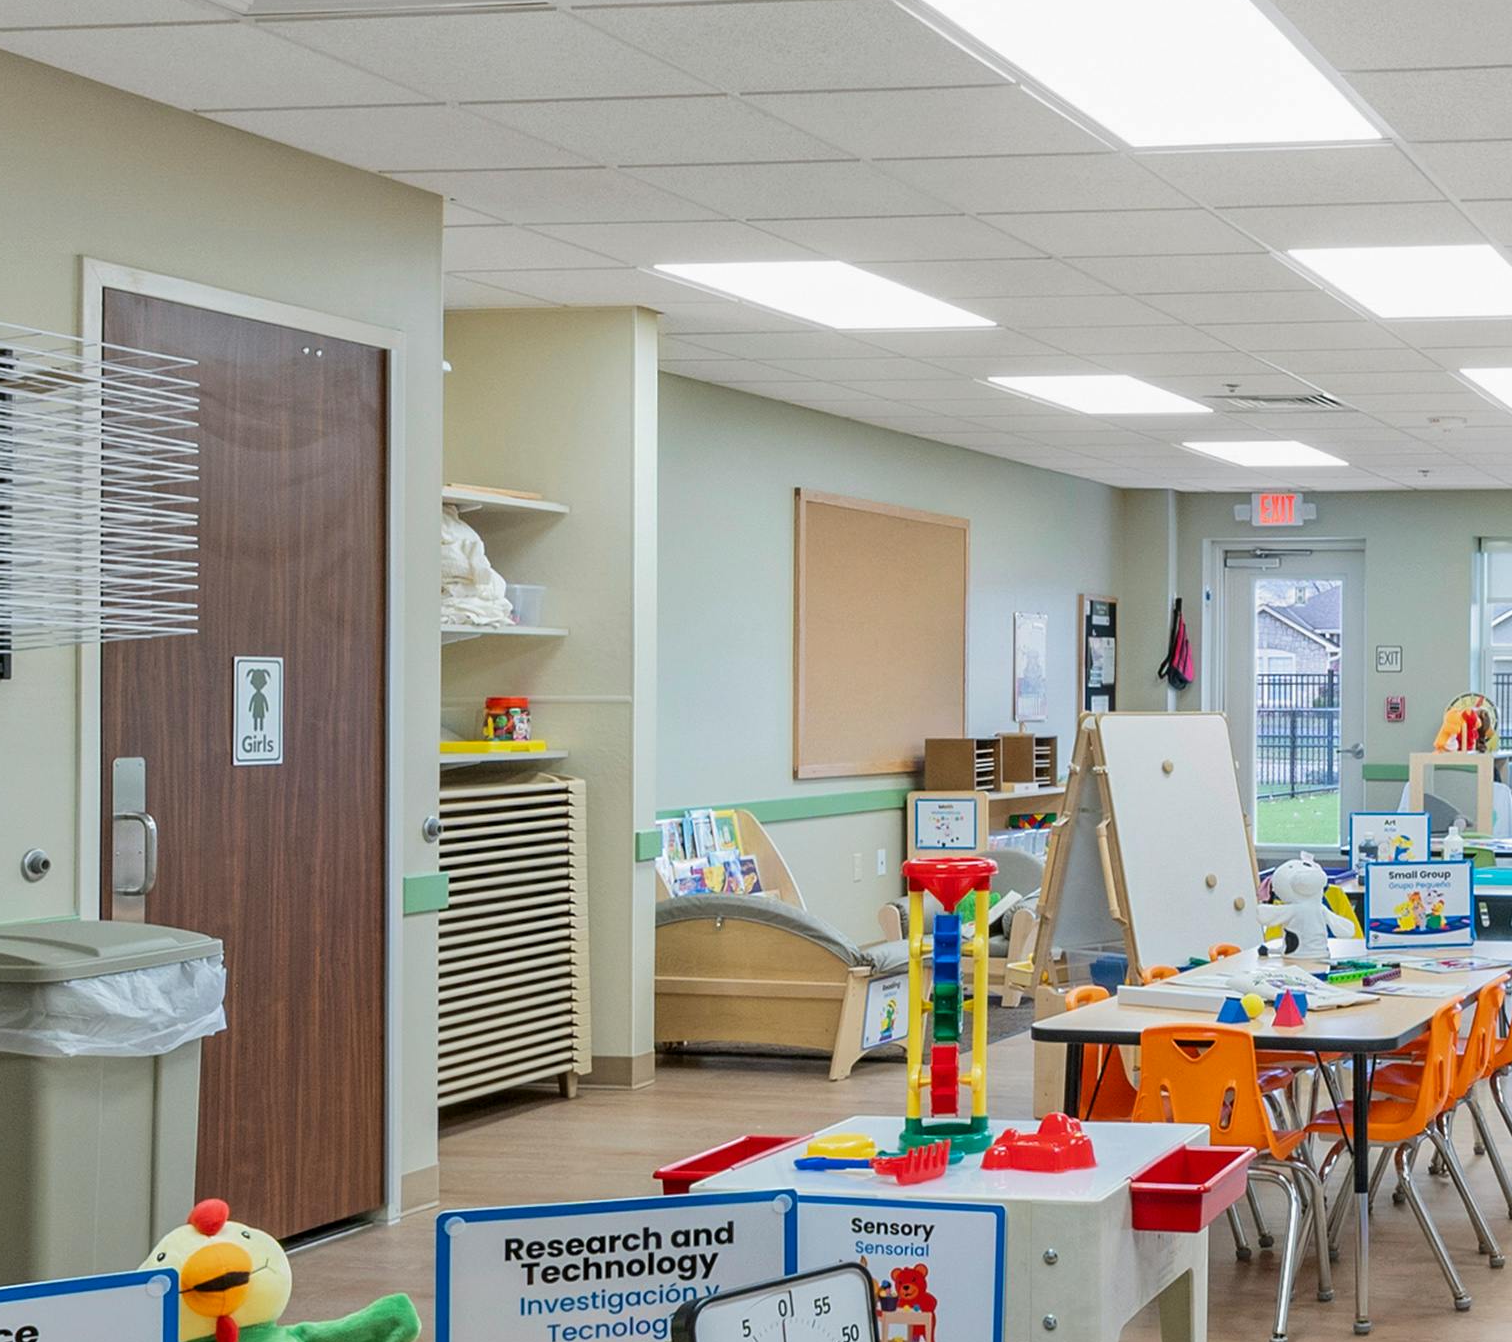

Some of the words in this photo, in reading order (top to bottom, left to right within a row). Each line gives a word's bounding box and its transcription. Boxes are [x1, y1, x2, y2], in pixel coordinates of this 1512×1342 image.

[1259, 494, 1297, 524] EXIT
[1378, 650, 1400, 666] EXIT
[241, 734, 274, 754] Girls
[1384, 819, 1397, 827] Art
[1388, 870, 1418, 880] Small
[1419, 870, 1452, 881] Group
[1388, 882, 1414, 890] Grupo
[1415, 880, 1452, 890] Pequeño
[851, 1217, 935, 1243] Sensory
[504, 1226, 663, 1262] Research
[670, 1221, 735, 1249] and
[855, 1240, 930, 1257] Sensorial
[520, 1252, 720, 1286] Technology
[520, 1282, 698, 1317] Investigación
[778, 1299, 788, 1318] 0
[814, 1296, 832, 1317] 55
[547, 1313, 674, 1342] Tecnolog
[742, 1319, 751, 1338] 5
